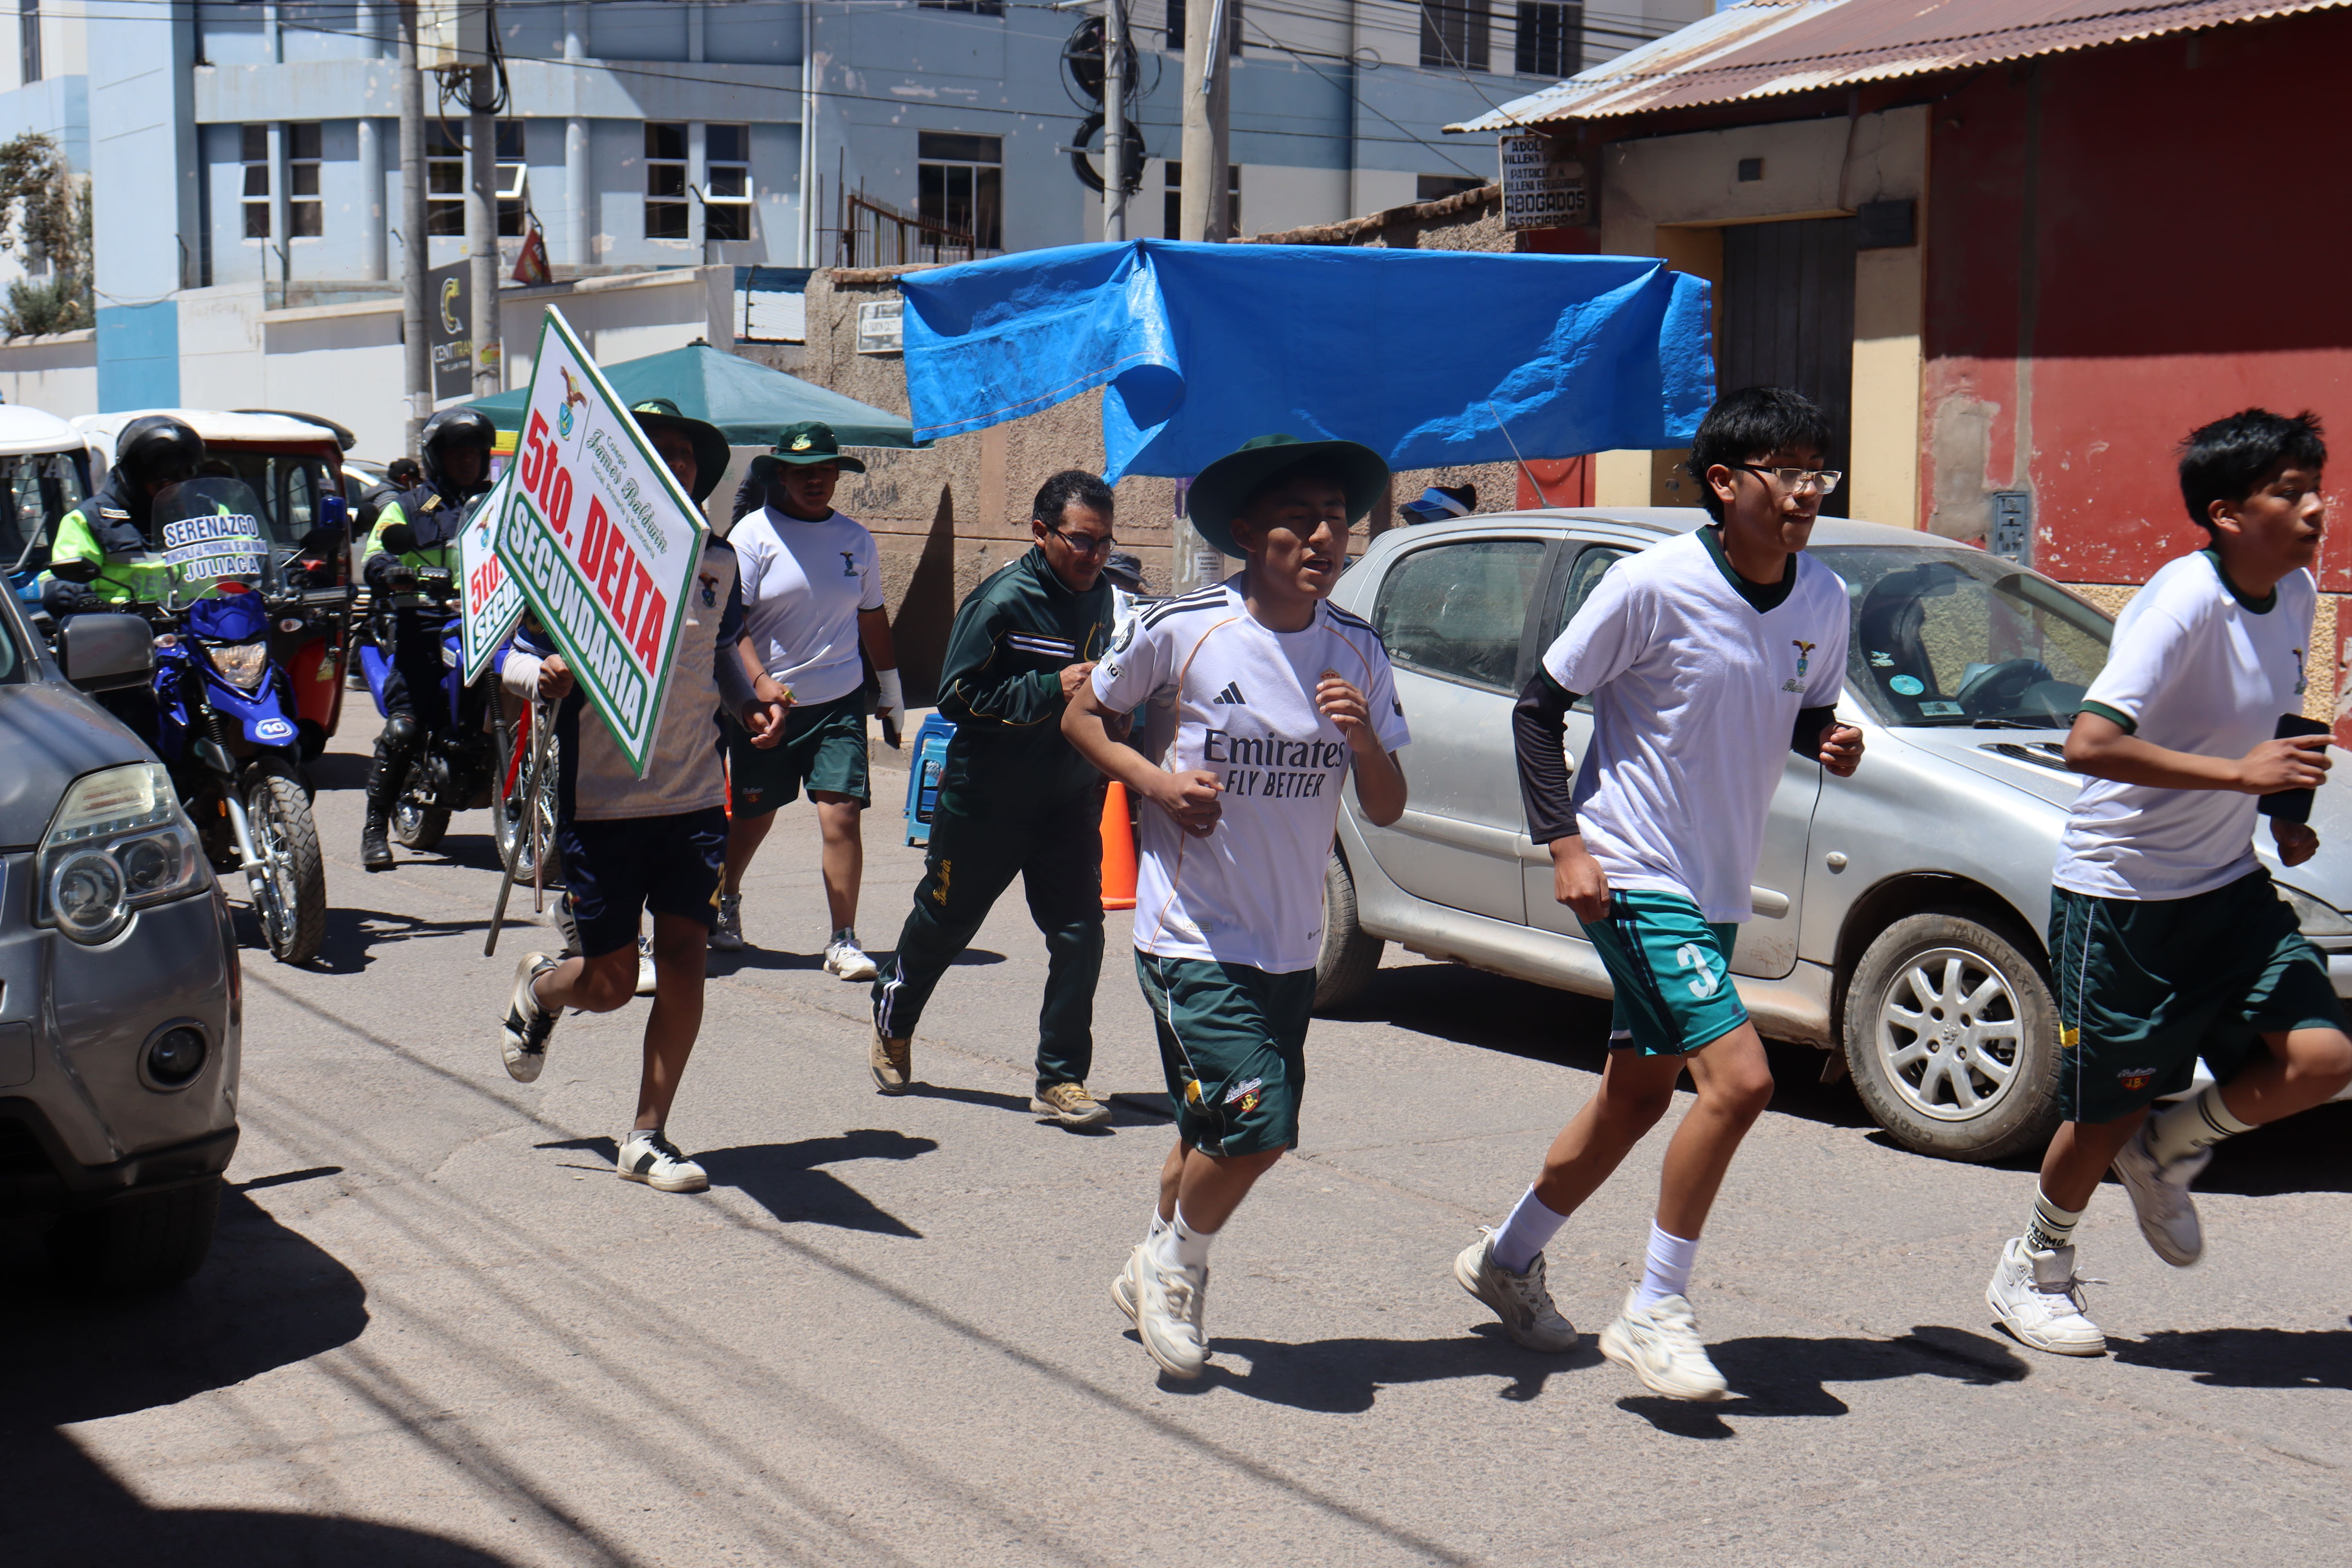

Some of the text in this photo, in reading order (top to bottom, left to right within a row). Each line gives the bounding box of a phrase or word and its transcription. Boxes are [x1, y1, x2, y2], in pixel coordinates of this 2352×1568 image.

[1505, 191, 1585, 213] ABOGADOS
[1509, 213, 1577, 228] ASOCIADOS
[607, 436, 627, 469] Colegio
[586, 428, 667, 554] James Baldwin
[164, 515, 258, 547] SERENAZGO
[606, 483, 626, 515] Primaria
[630, 518, 655, 560] Secundaria
[522, 408, 667, 679] 5to. DELTA
[185, 557, 260, 581] JULIACA
[470, 553, 504, 616] 5to.
[510, 505, 644, 731] SECUNDARIA
[262, 722, 285, 733] 10
[1204, 728, 1345, 768] Emirates
[1225, 769, 1326, 798] FLY BETTER
[1677, 942, 1719, 998] 3
[2003, 950, 2034, 996] TAXI
[2031, 1220, 2066, 1246] PROMO
